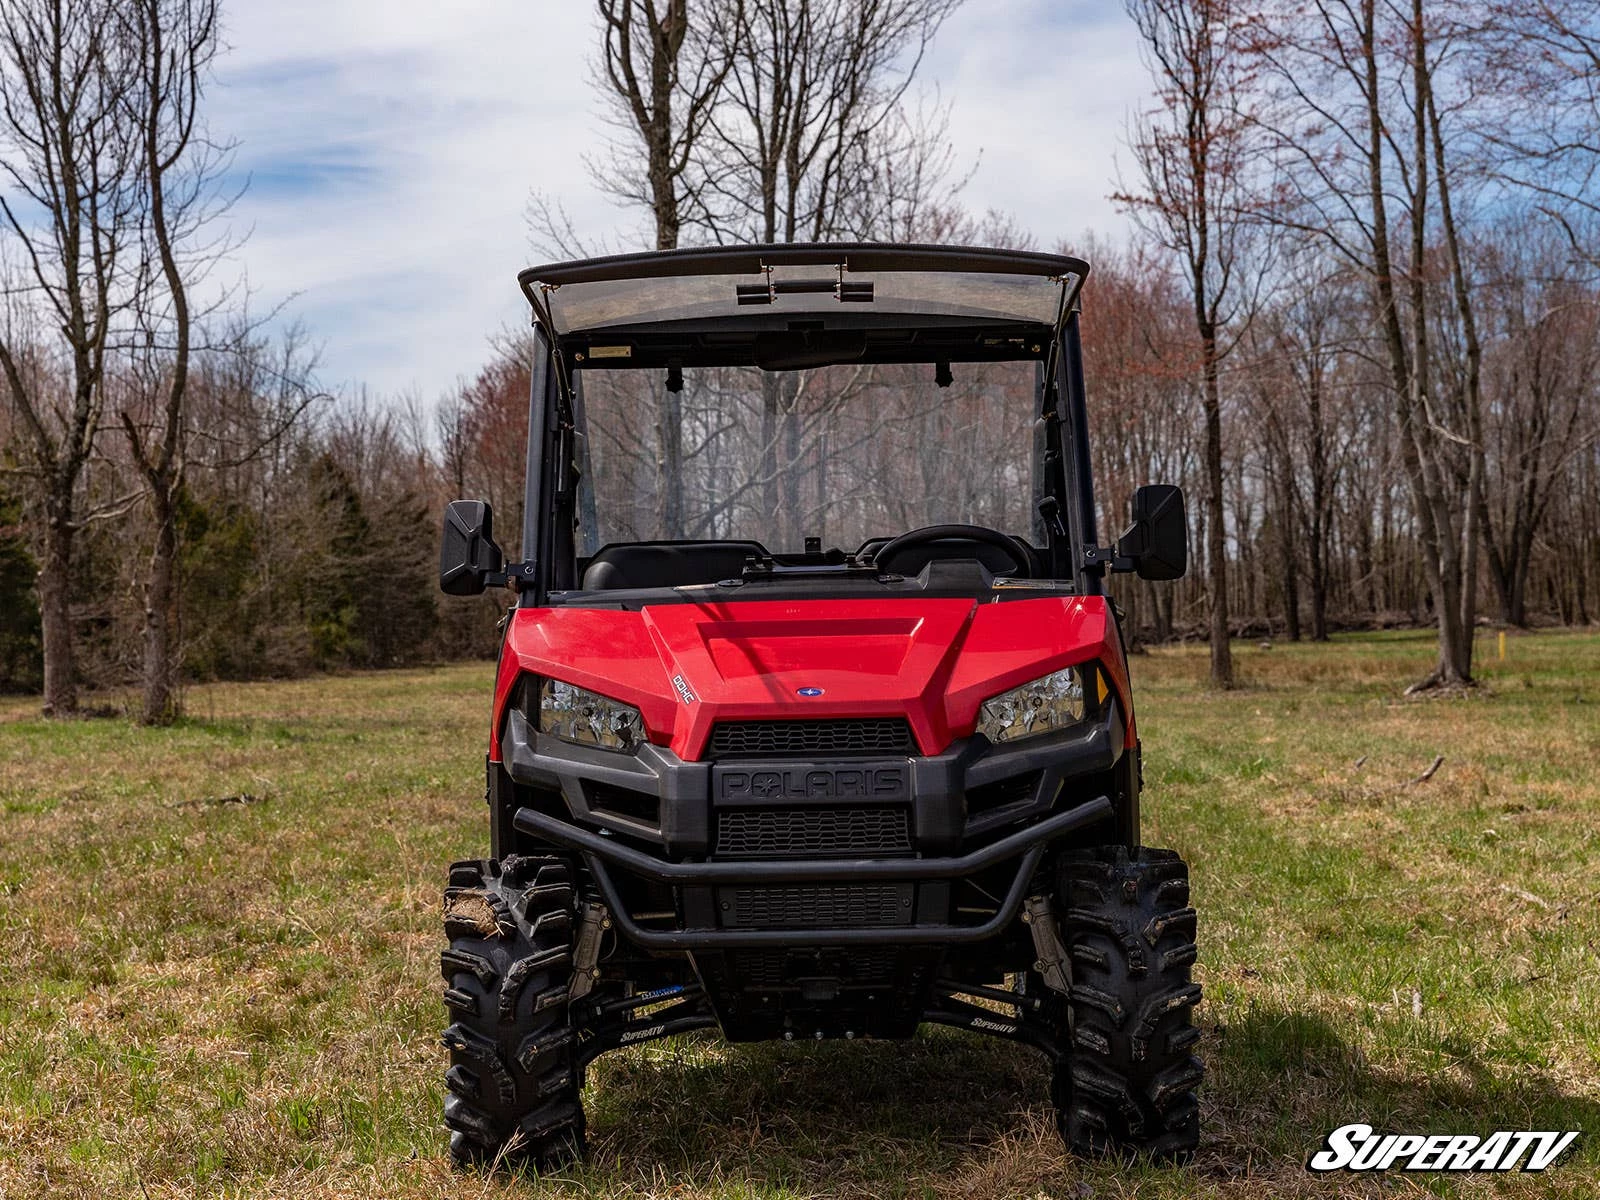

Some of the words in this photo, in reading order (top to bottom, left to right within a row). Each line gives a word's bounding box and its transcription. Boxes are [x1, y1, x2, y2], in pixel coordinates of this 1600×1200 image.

[672, 674, 696, 705] DOHC
[721, 768, 904, 799] POLARIS
[620, 1024, 663, 1042] SUPERATV
